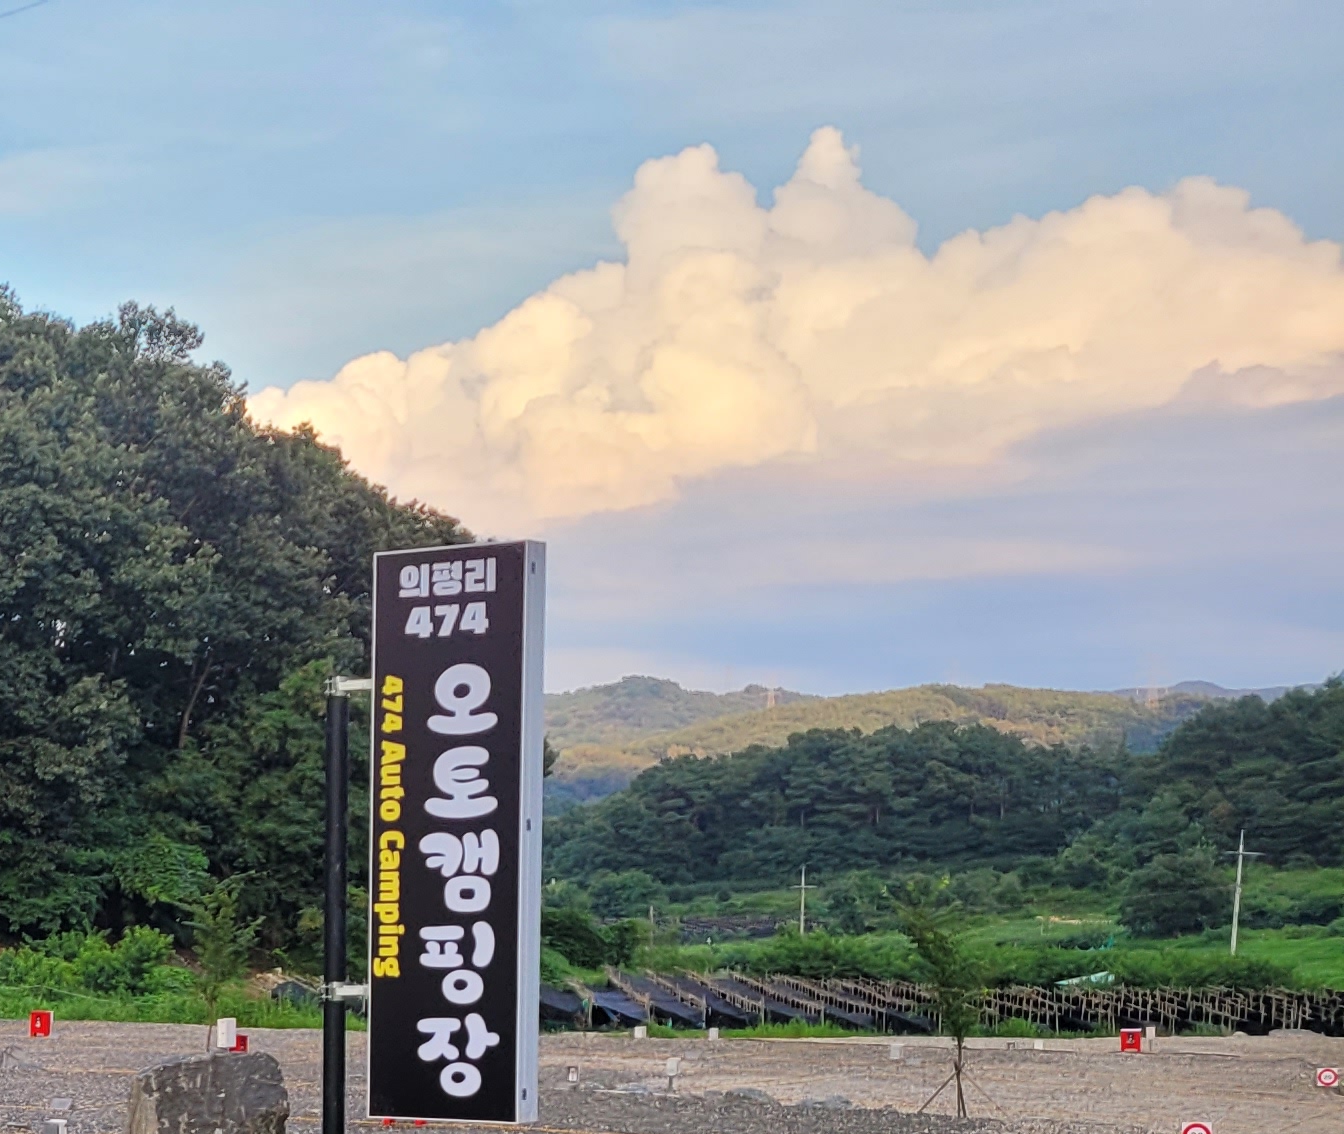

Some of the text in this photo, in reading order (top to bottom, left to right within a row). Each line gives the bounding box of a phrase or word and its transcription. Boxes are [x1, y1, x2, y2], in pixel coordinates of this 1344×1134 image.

[398, 557, 497, 598] 의평리
[404, 601, 490, 639] 474
[373, 675, 406, 977] 474 Auto Camping
[417, 663, 500, 1097] 오토캠핑장
